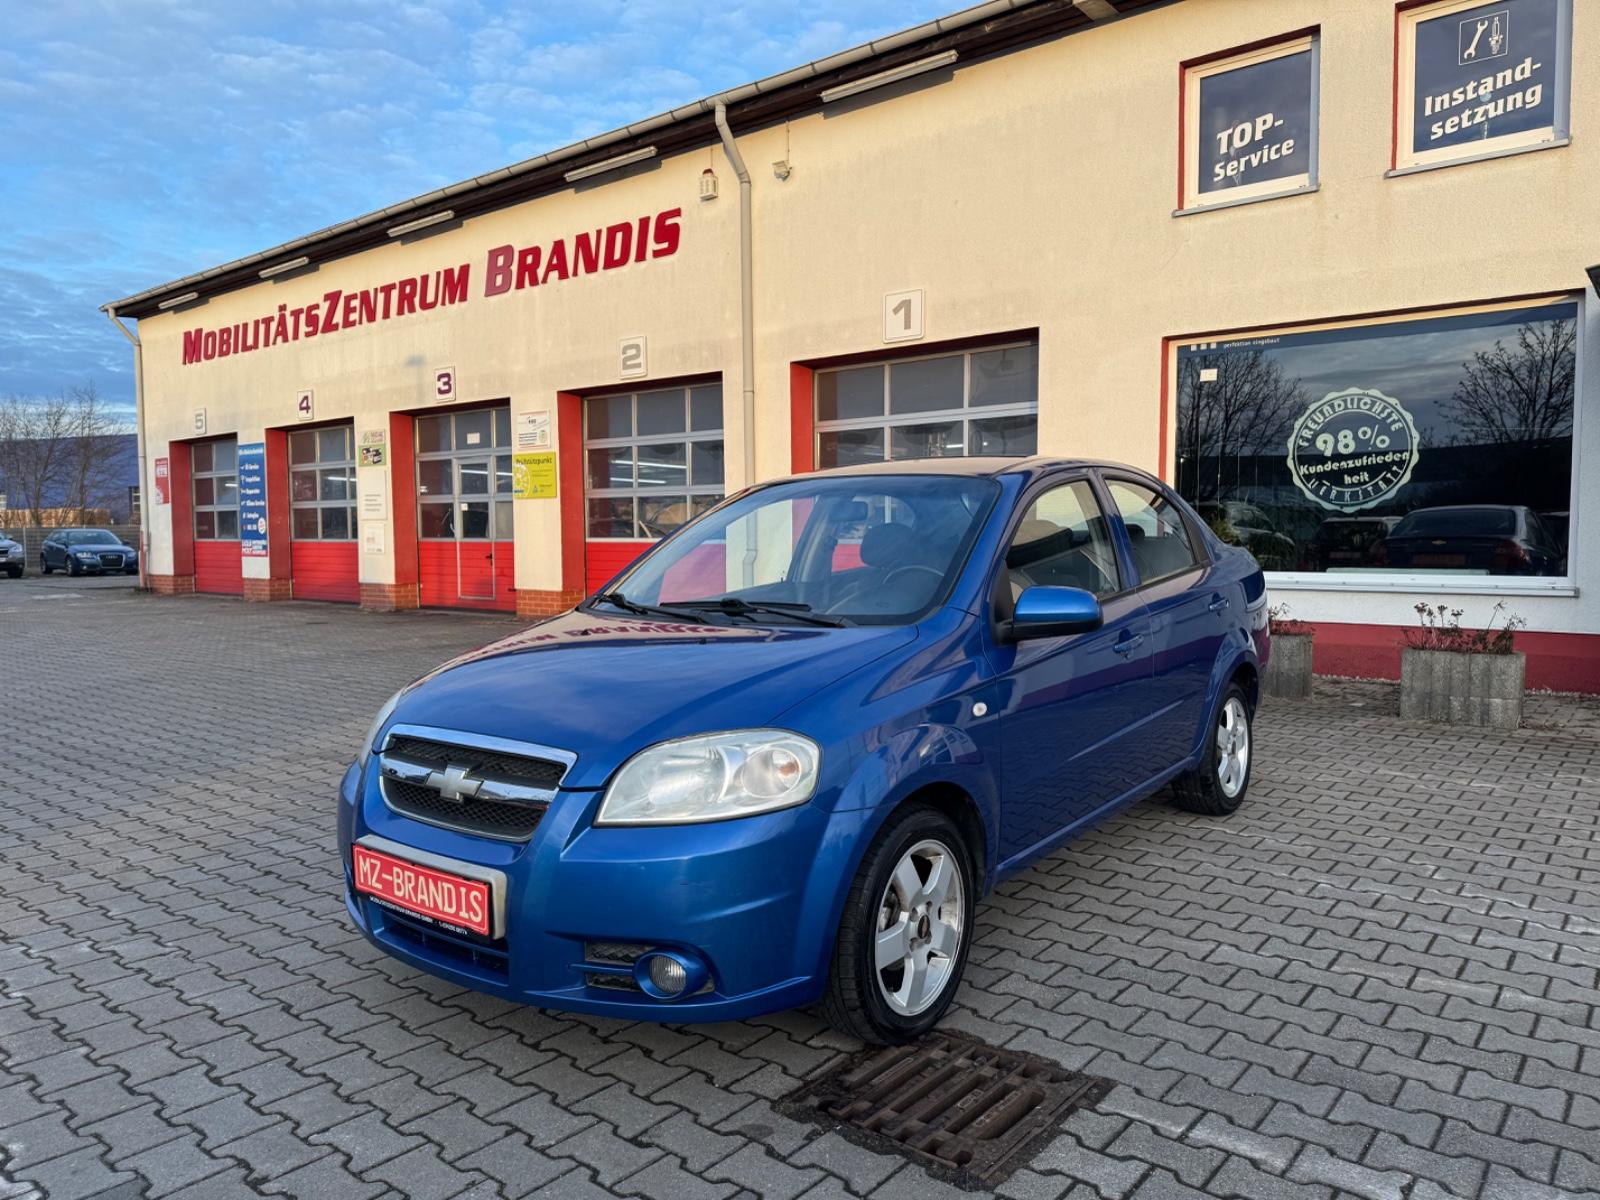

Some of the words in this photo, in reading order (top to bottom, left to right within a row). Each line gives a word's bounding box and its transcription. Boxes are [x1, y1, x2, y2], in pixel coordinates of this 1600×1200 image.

[1424, 56, 1542, 117] Instand-
[1430, 83, 1543, 141] setzung
[1216, 112, 1284, 155] TOP-
[484, 207, 682, 298] BRANDIS
[892, 298, 912, 330] 1
[621, 343, 642, 371] 2
[437, 372, 453, 395] 3
[298, 395, 311, 414] 4
[195, 413, 204, 429] 5
[1344, 471, 1369, 485] heit
[359, 855, 483, 923] MZ-BRANDIS
